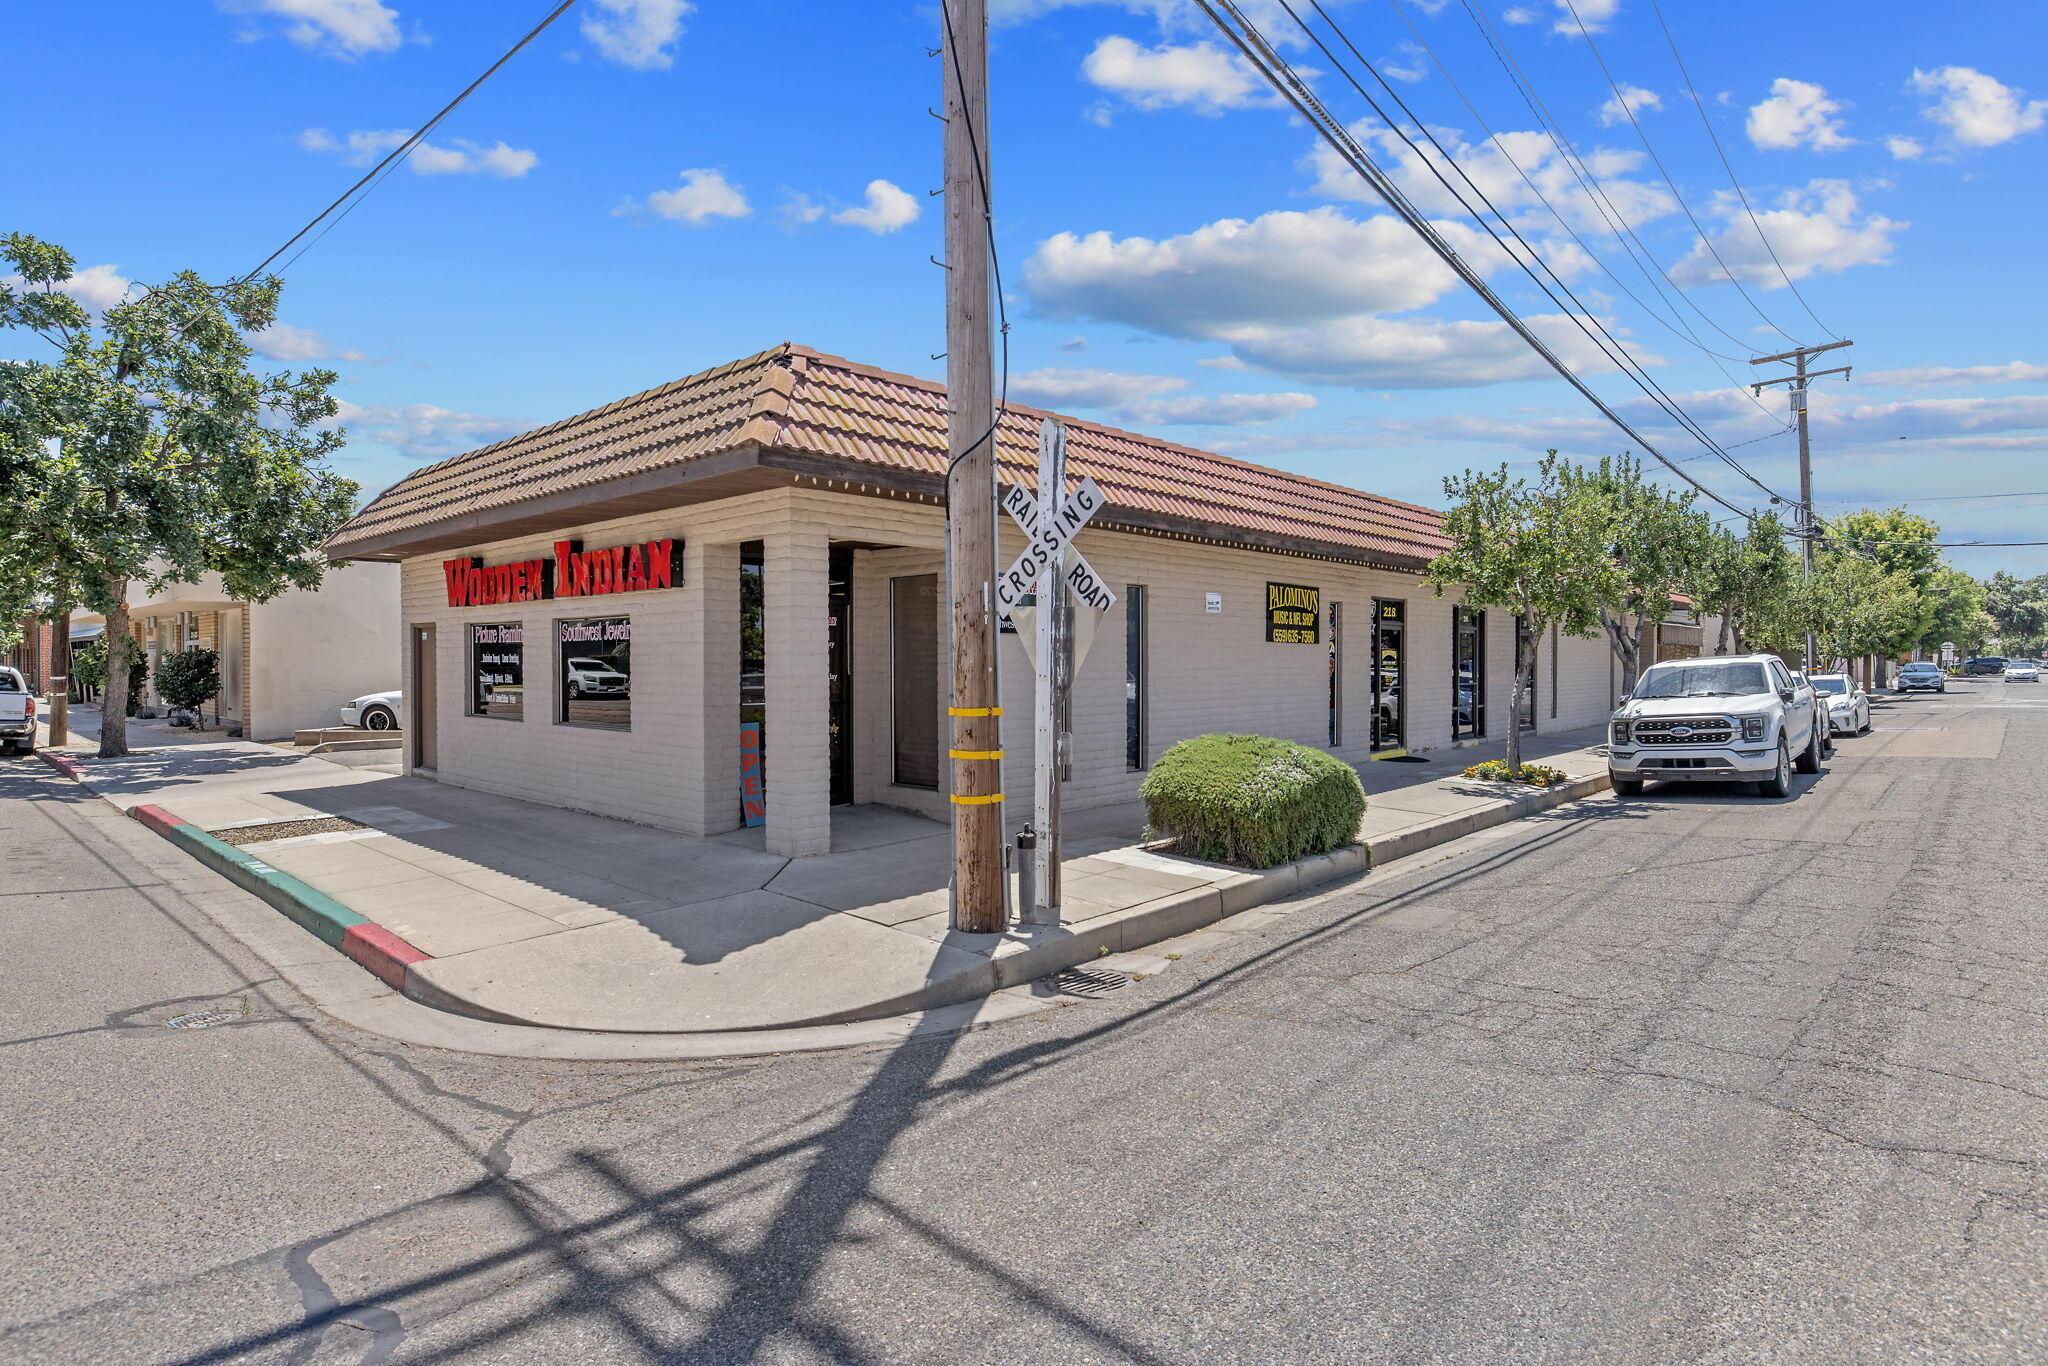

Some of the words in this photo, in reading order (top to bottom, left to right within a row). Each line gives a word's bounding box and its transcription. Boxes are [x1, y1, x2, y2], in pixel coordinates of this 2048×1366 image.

[999, 490, 1093, 604] CROSSING
[443, 557, 544, 607] WOODEN
[554, 539, 676, 597] INDIAN
[1269, 584, 1318, 614] PALOMINO'S
[1383, 606, 1396, 617] 218
[562, 622, 602, 641] Southwest
[604, 620, 631, 640] Jewelr
[1273, 610, 1288, 624] MUSIC
[1302, 613, 1314, 627] SHOP
[475, 626, 497, 643] Picture
[498, 625, 523, 643] Framin
[741, 730, 764, 818] OPEN
